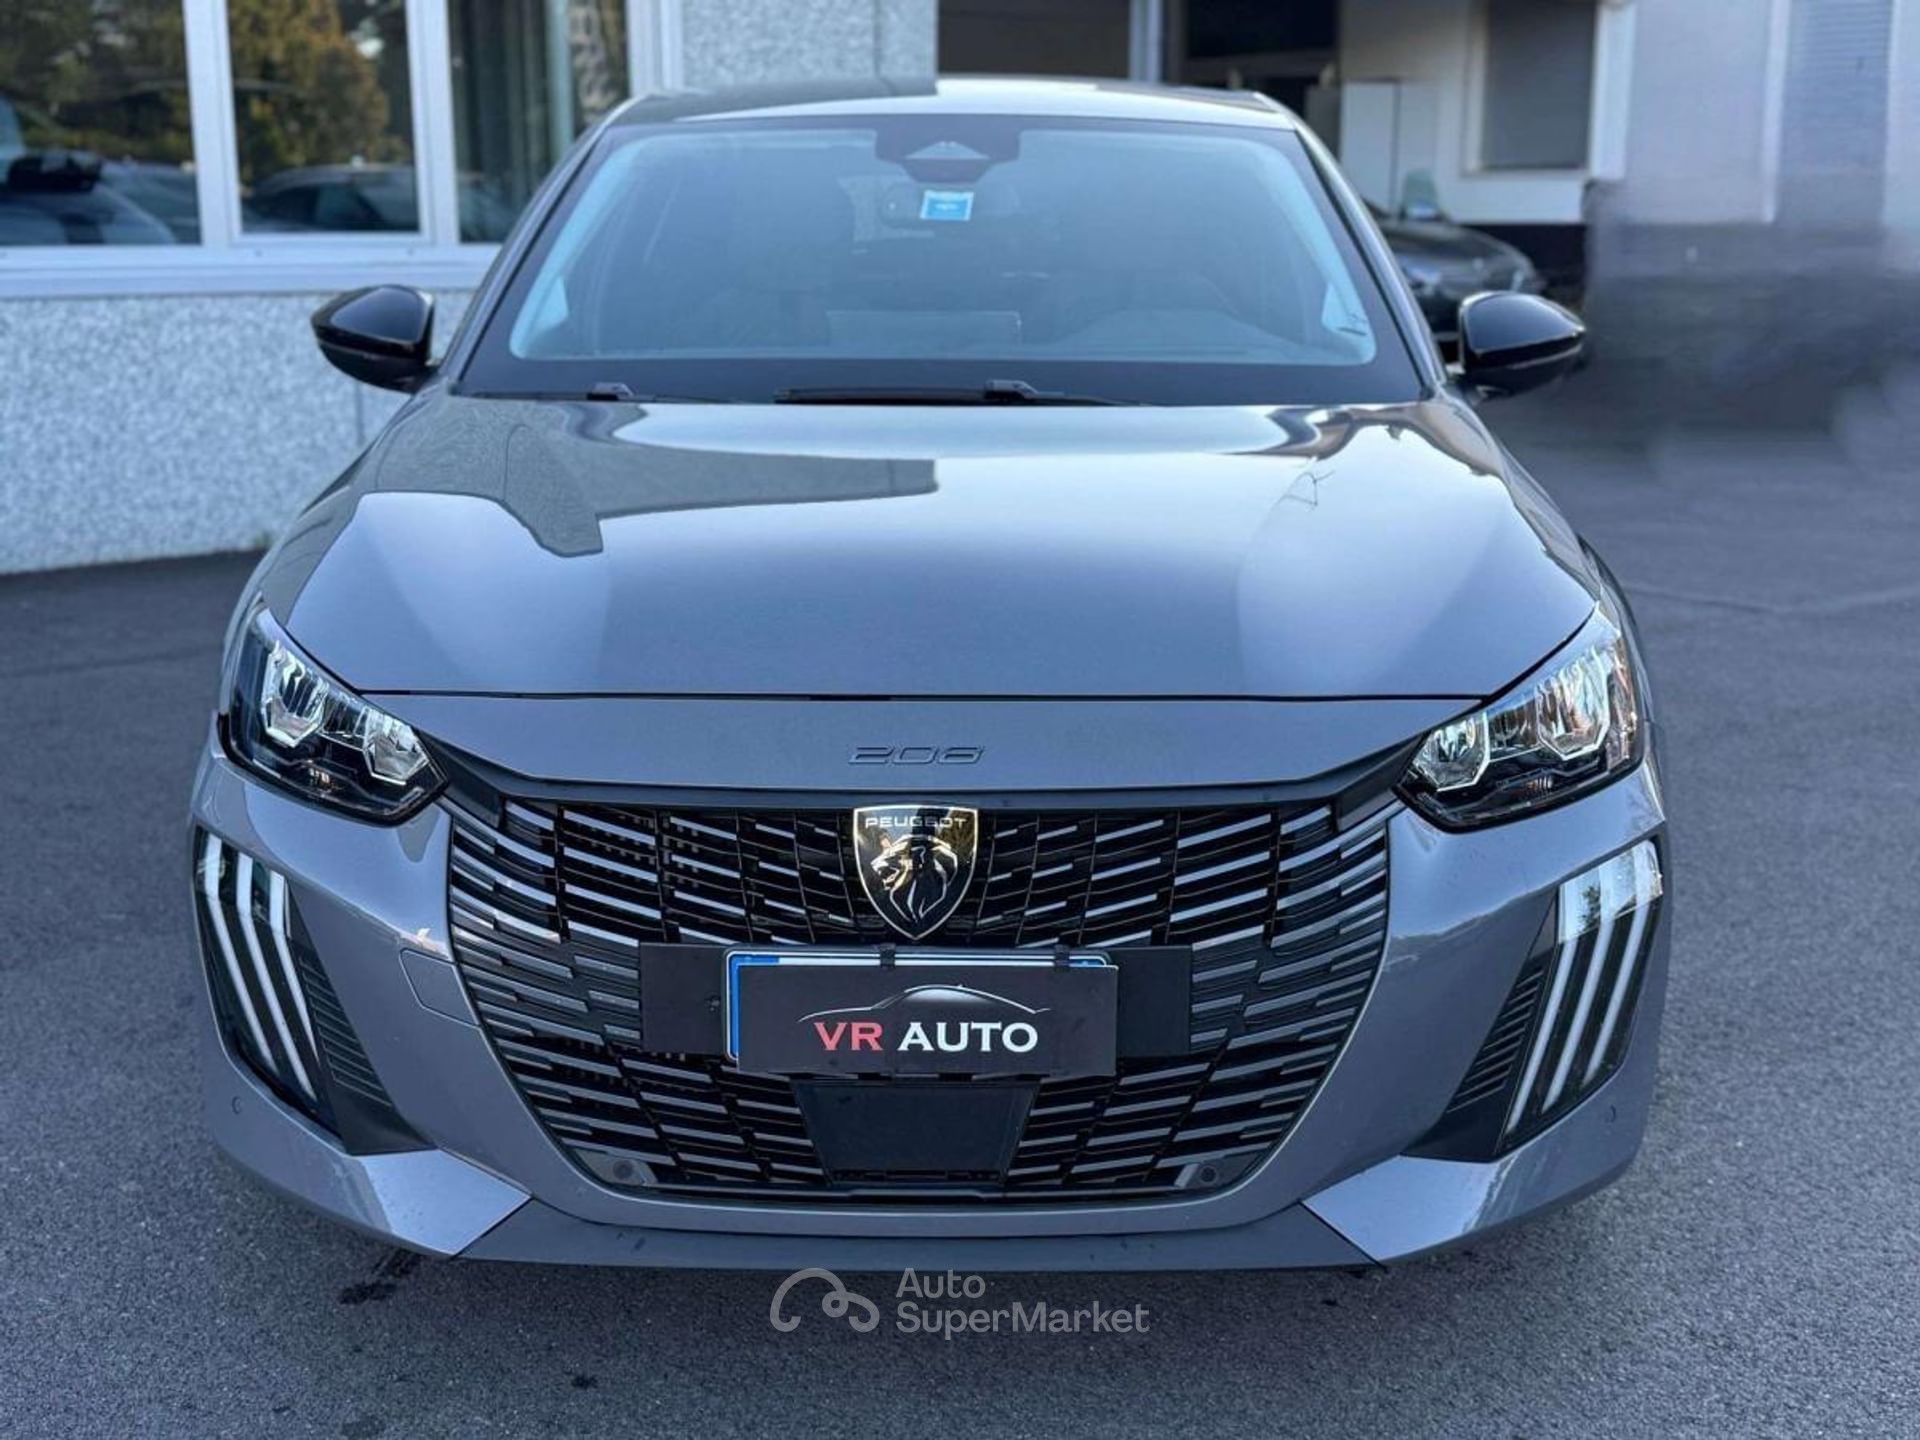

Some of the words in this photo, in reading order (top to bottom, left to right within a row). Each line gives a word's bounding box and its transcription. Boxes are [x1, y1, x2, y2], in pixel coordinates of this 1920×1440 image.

[848, 746, 984, 765] 208
[865, 816, 967, 829] PEUGEOT
[814, 1021, 883, 1051] VR
[897, 1021, 1038, 1053] AUTO
